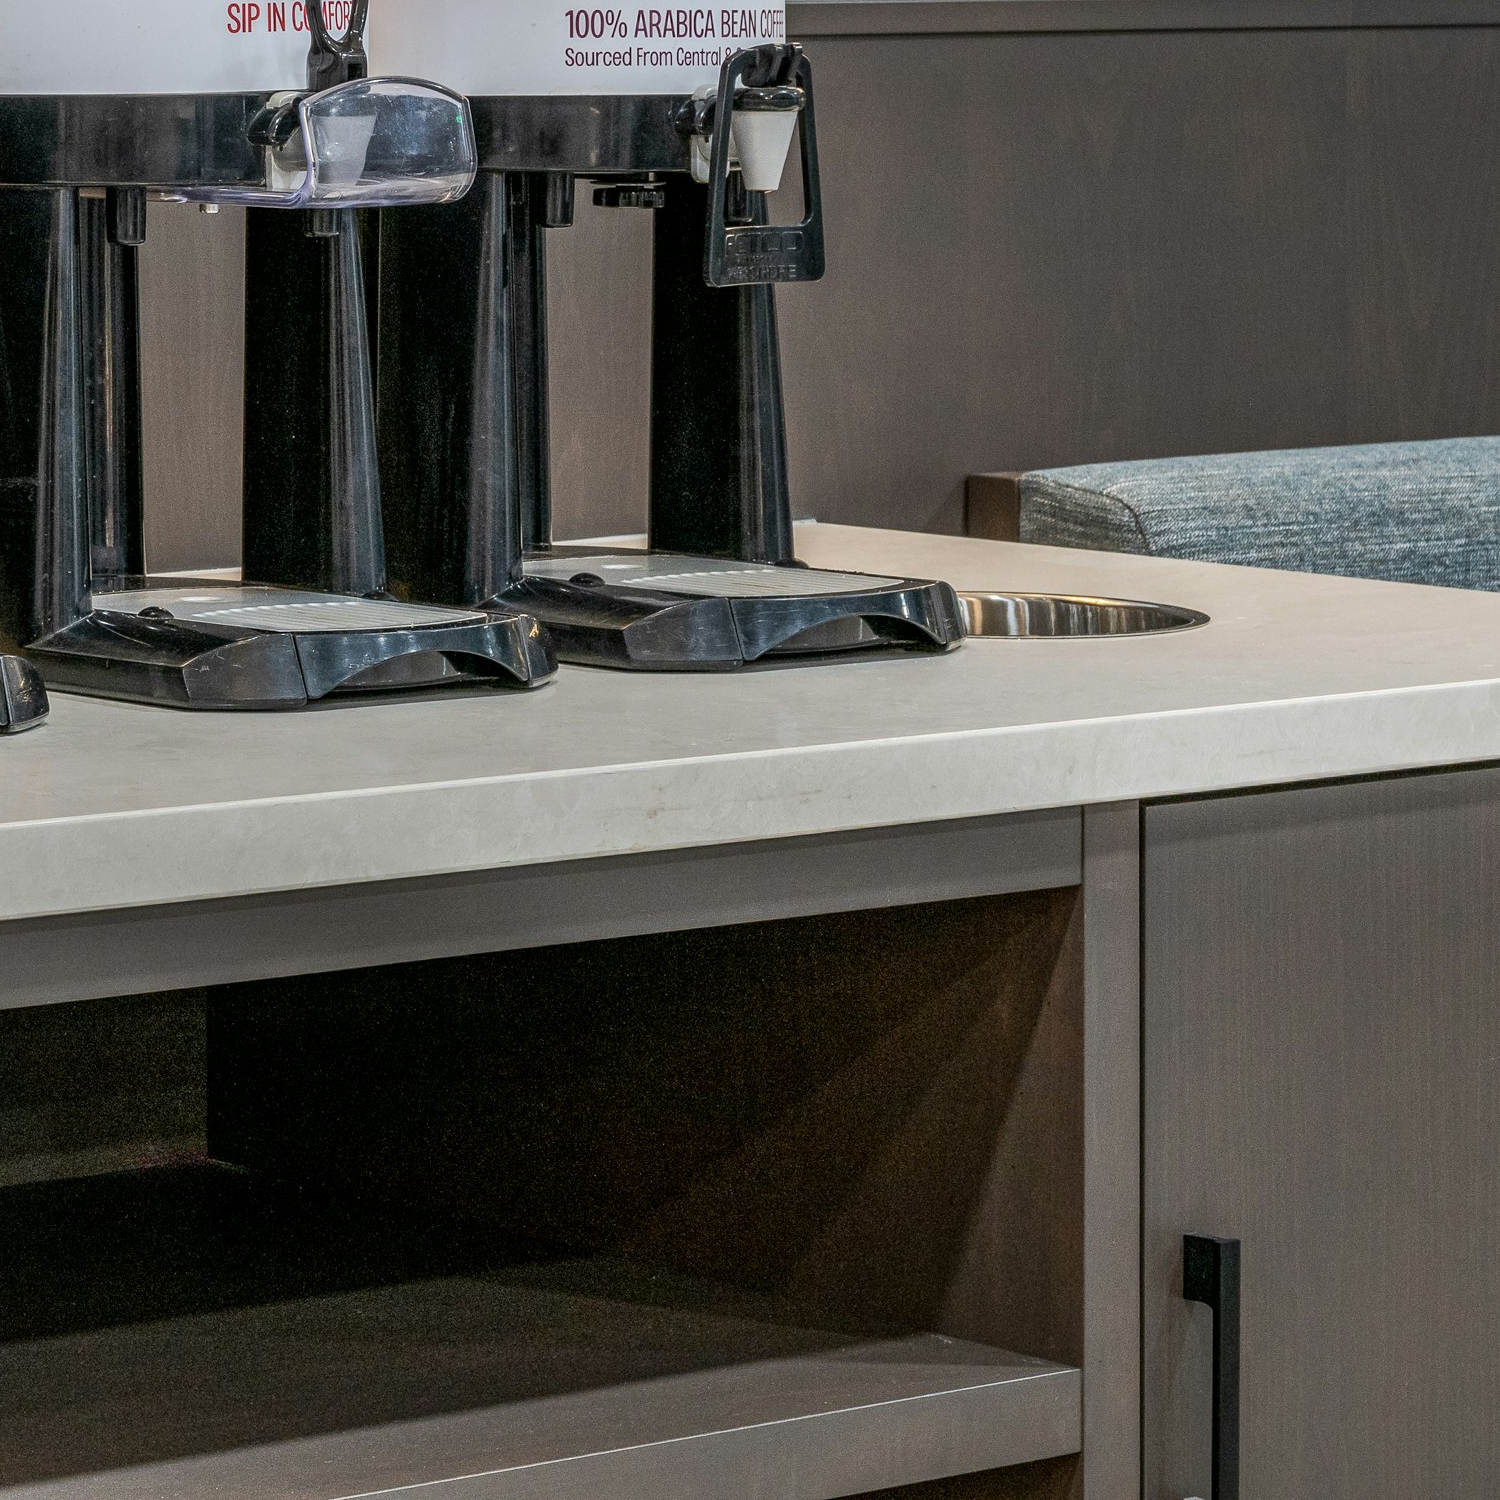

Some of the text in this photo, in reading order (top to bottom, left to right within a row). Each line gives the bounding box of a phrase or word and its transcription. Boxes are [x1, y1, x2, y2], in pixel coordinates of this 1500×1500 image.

[227, 2, 261, 33] SIP
[267, 2, 286, 32] IN
[565, 9, 628, 39] 100%
[634, 9, 715, 38] ARABICA
[721, 9, 757, 38] BEAN
[565, 47, 632, 67] Sourced
[637, 48, 673, 66] From
[676, 47, 722, 66] Central
